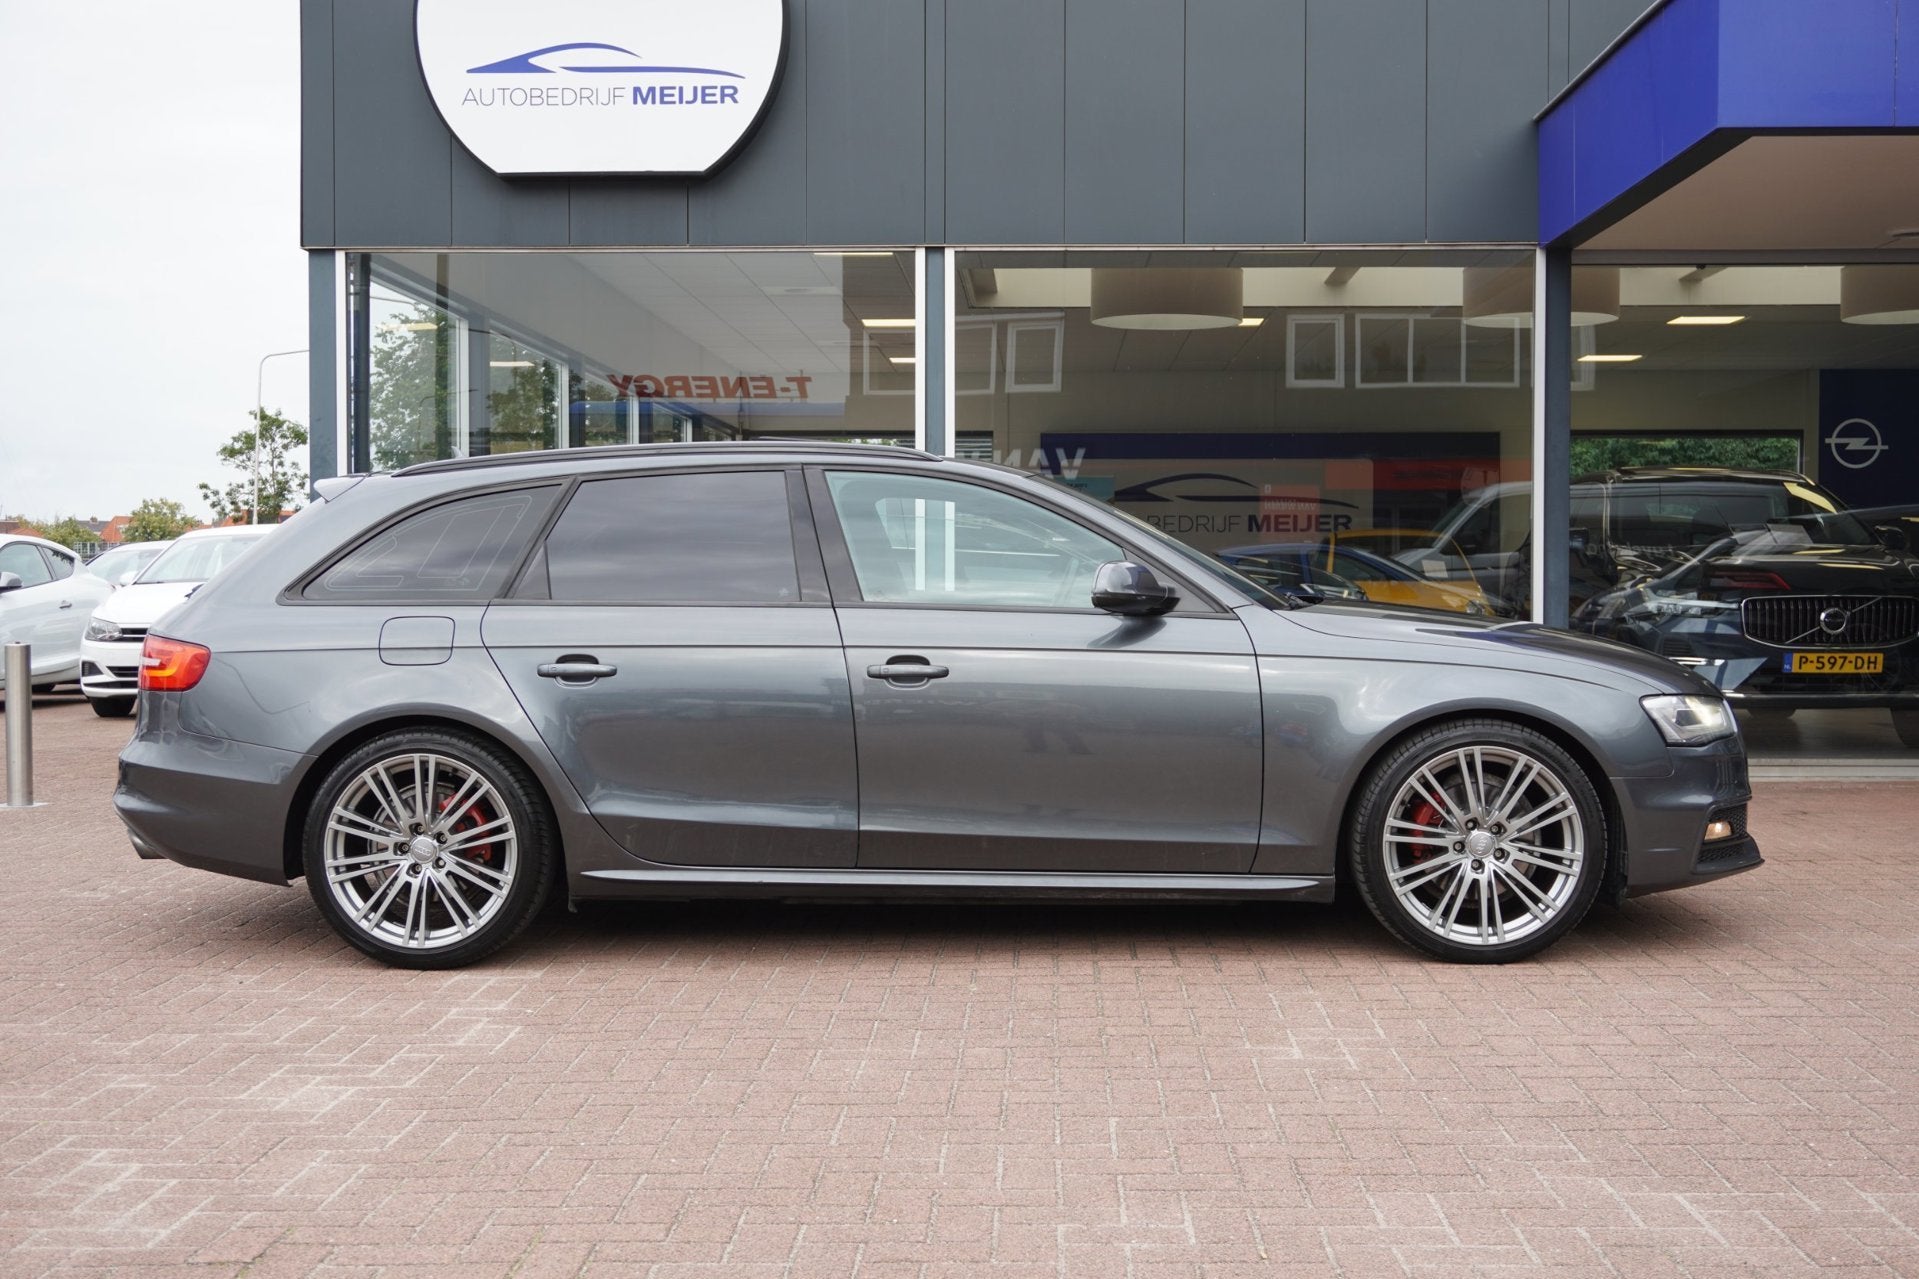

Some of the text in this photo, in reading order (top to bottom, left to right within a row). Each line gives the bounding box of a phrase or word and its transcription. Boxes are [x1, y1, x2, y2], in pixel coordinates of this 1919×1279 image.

[461, 85, 740, 107] AUTOBEDRIJF MEIJER
[1247, 514, 1353, 533] MEIJER
[1798, 655, 1878, 671] P-597-DH
